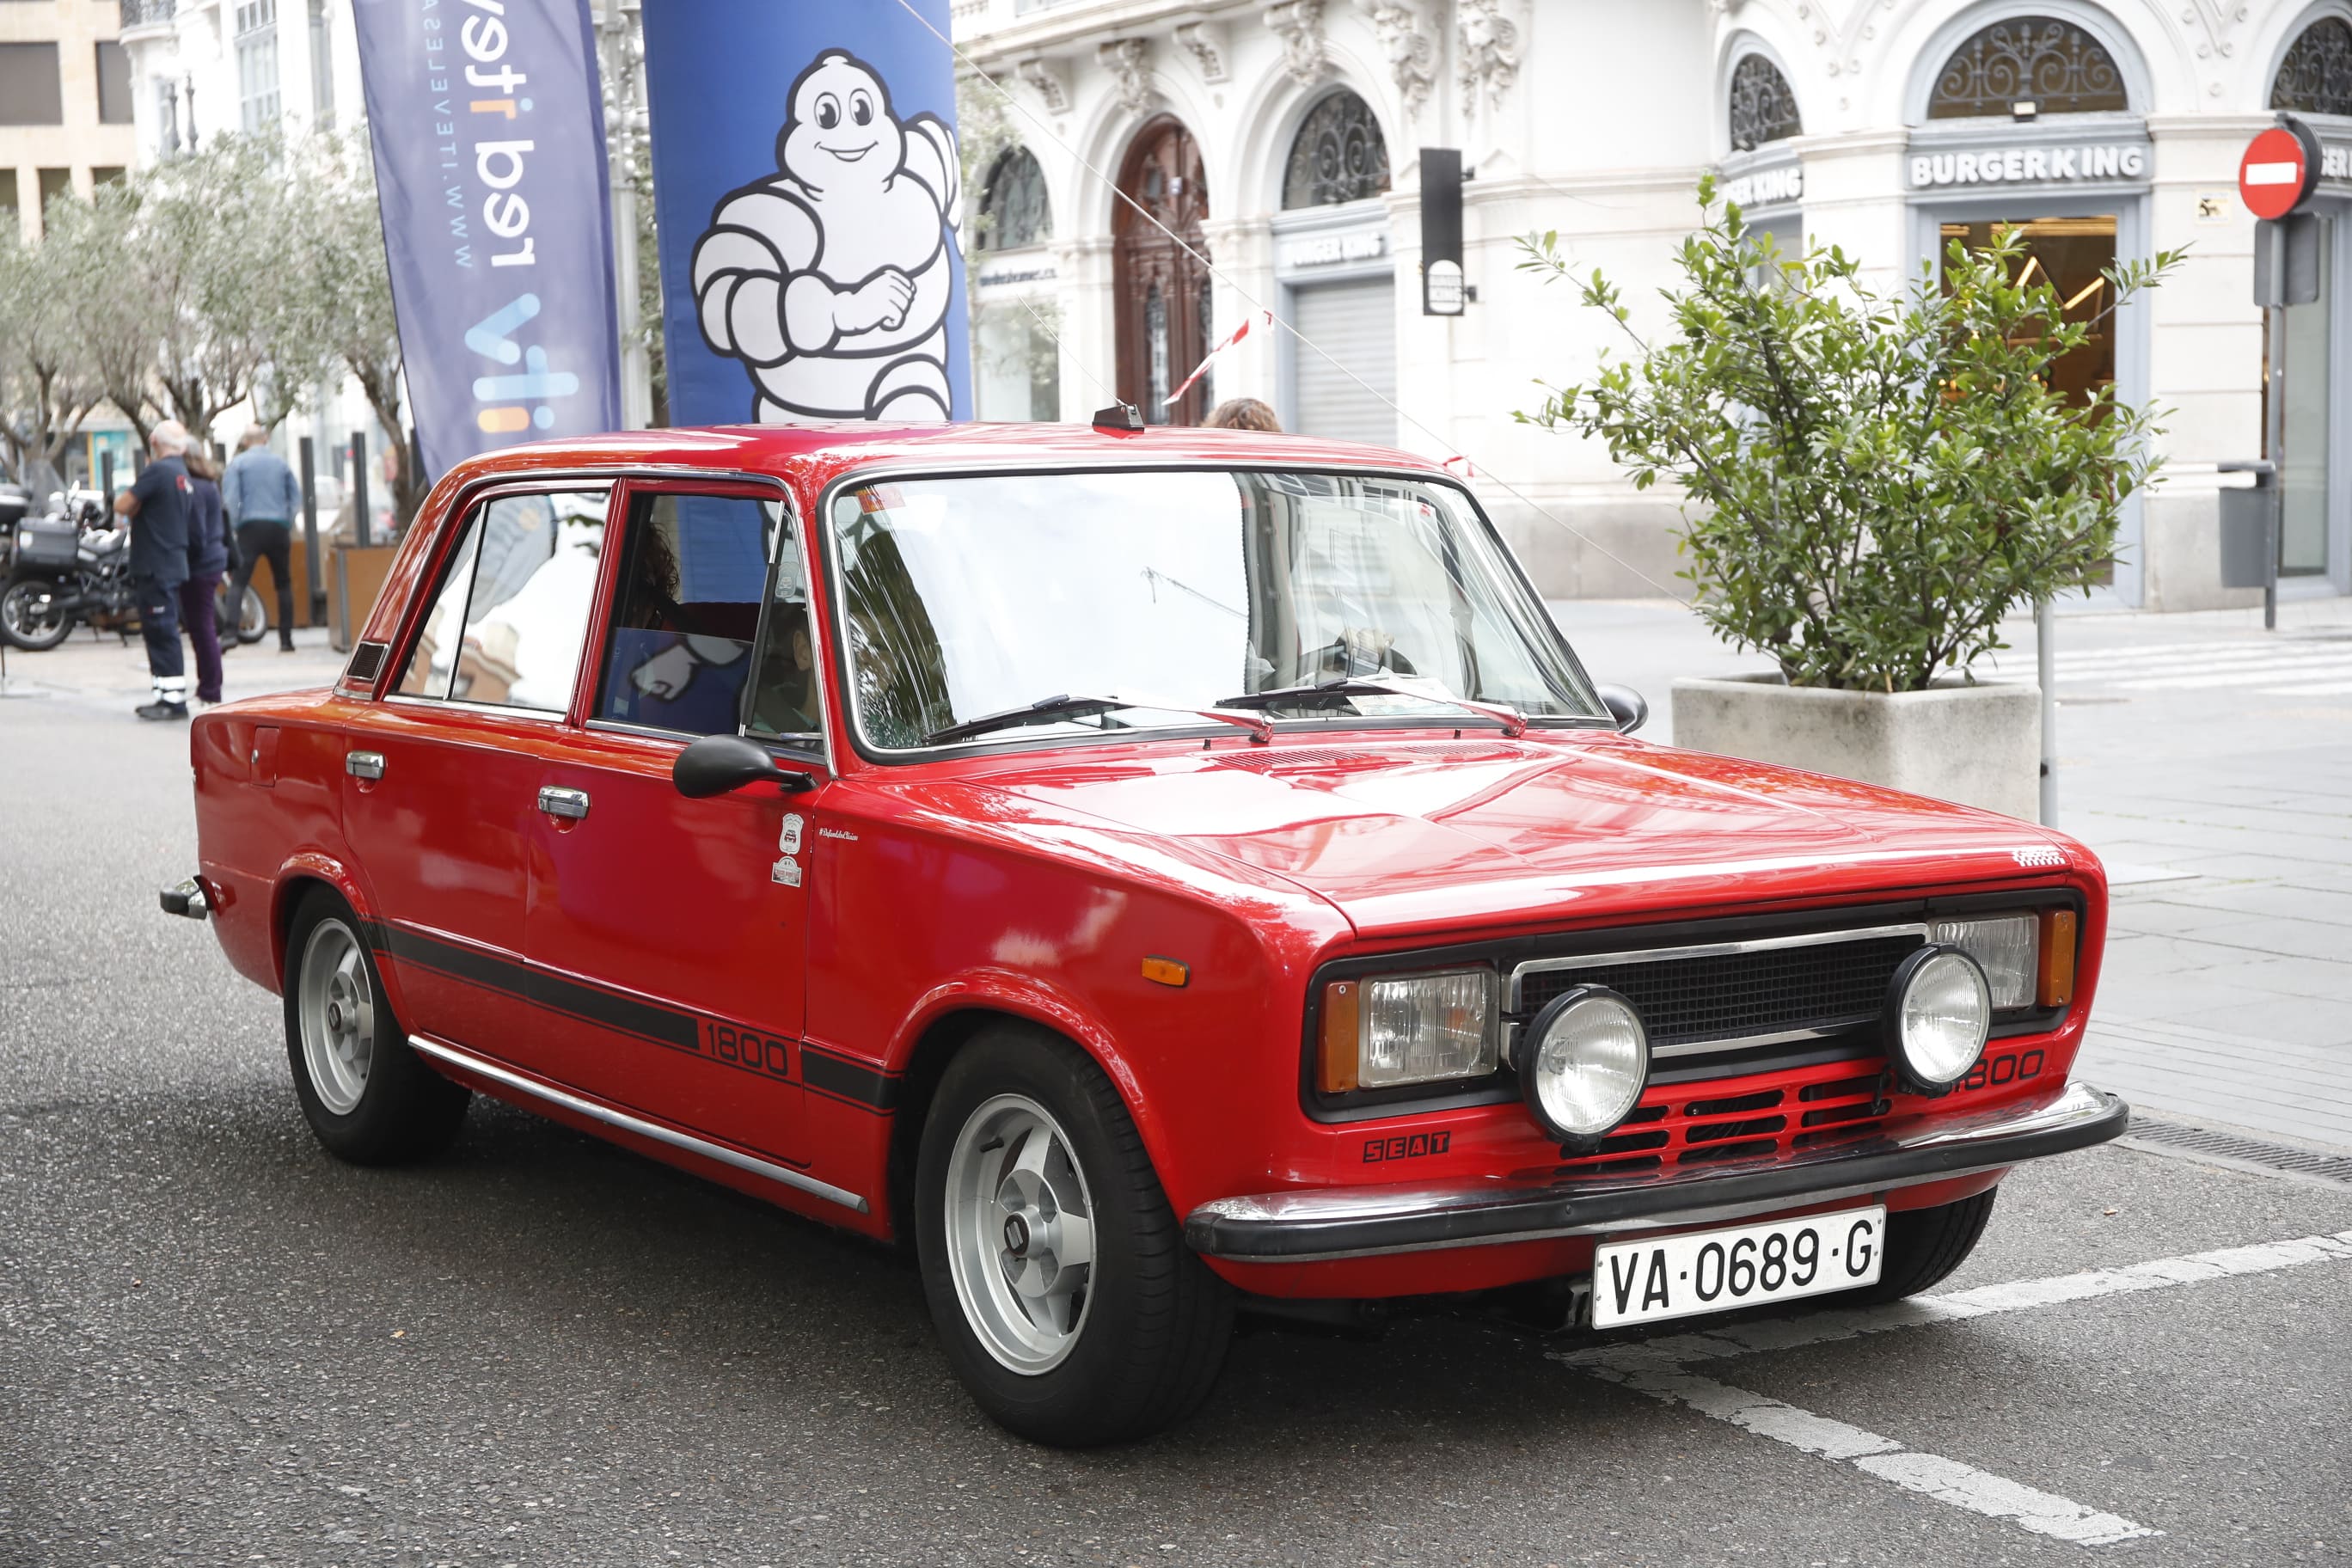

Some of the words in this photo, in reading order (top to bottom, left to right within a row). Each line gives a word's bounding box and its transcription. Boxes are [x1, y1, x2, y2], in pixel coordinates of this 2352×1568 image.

[1753, 168, 1801, 201] KING
[1910, 150, 2048, 187] BURGER
[2051, 146, 2144, 180] KING
[707, 1023, 788, 1076] 1800
[1363, 1130, 1450, 1163] SEAT
